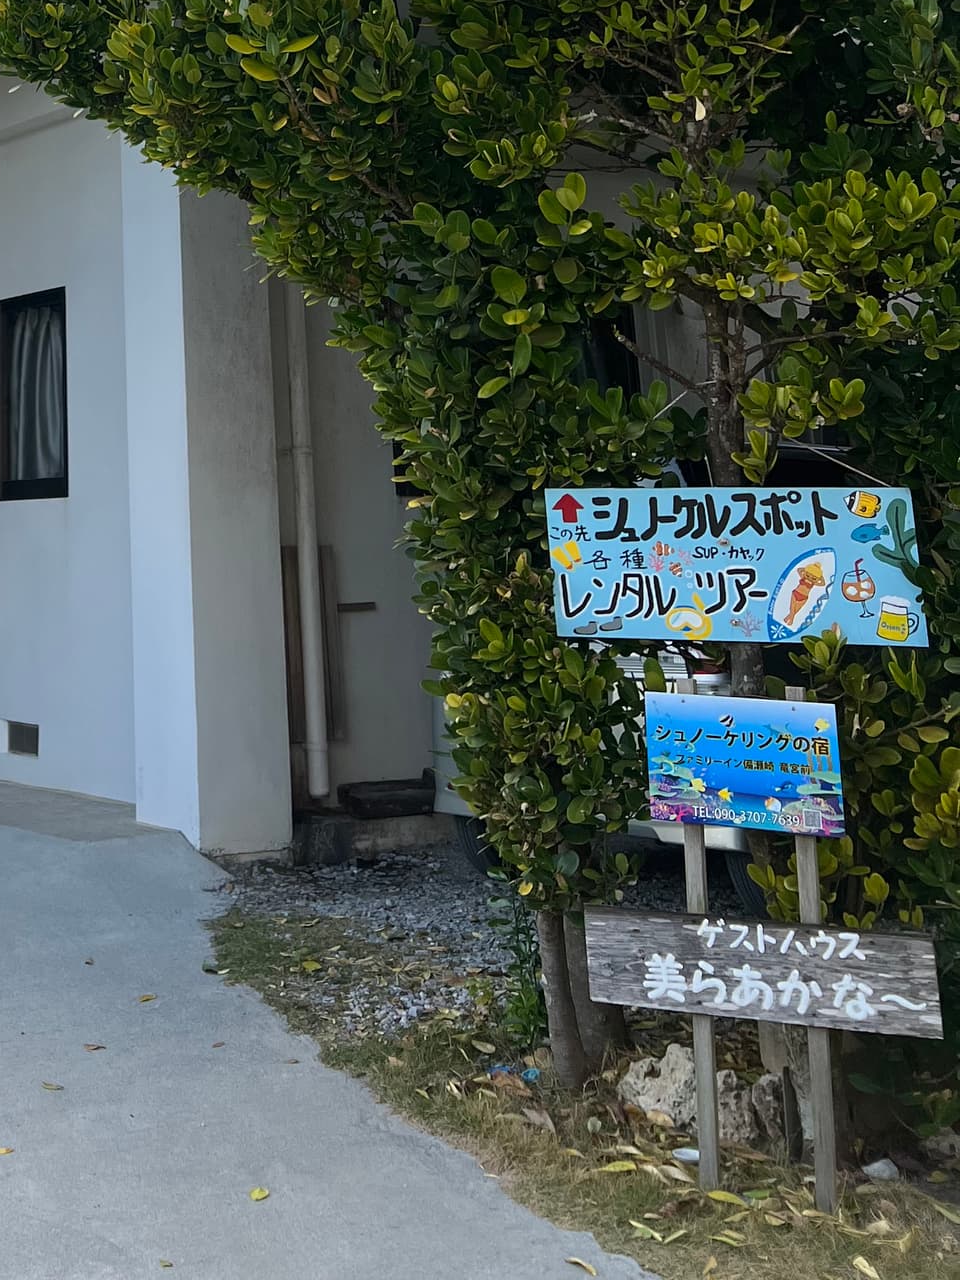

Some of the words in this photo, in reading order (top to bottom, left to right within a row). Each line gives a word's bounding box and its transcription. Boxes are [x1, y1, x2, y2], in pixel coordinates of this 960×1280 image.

[549, 526, 590, 542] この先
[561, 572, 677, 619] レンタル
[695, 568, 768, 615] ツアー
[655, 723, 830, 756] シュノーケリングの宿
[697, 918, 866, 961] ゲストハウス
